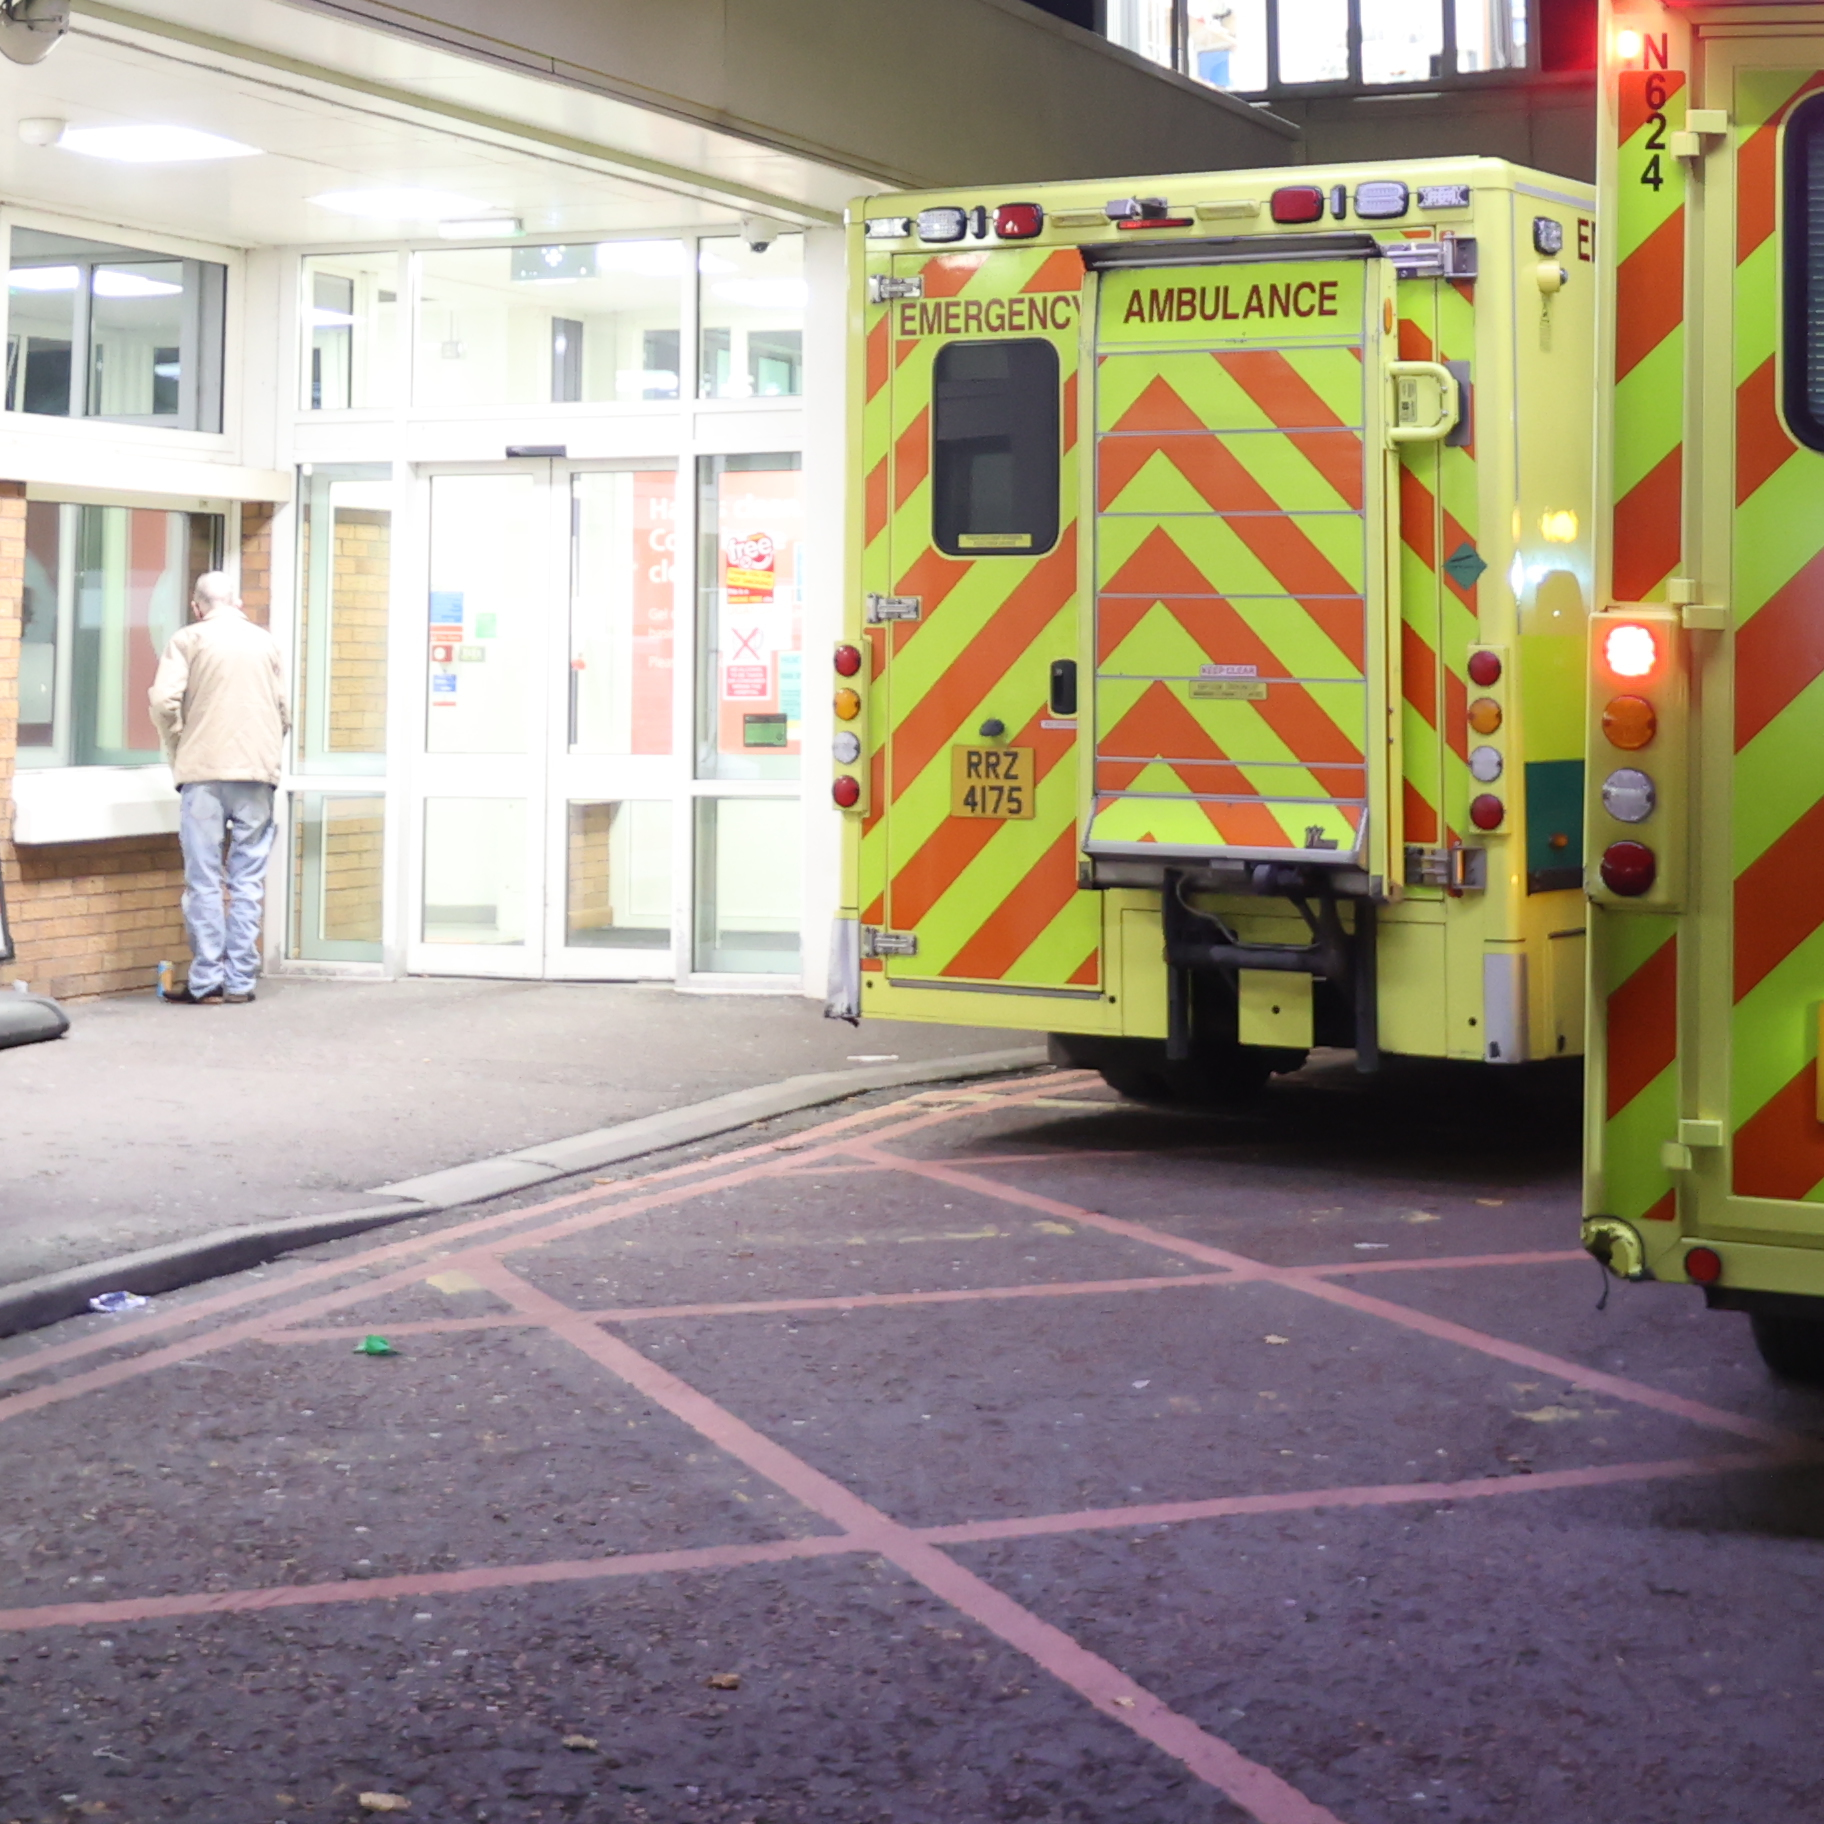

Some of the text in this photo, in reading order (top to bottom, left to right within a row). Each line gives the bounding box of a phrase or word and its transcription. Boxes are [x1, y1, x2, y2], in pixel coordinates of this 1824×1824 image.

[1123, 280, 1339, 325] AMBULANCE
[728, 536, 774, 564] free
[966, 750, 1019, 780] RRZ
[963, 784, 1023, 815] 4175
